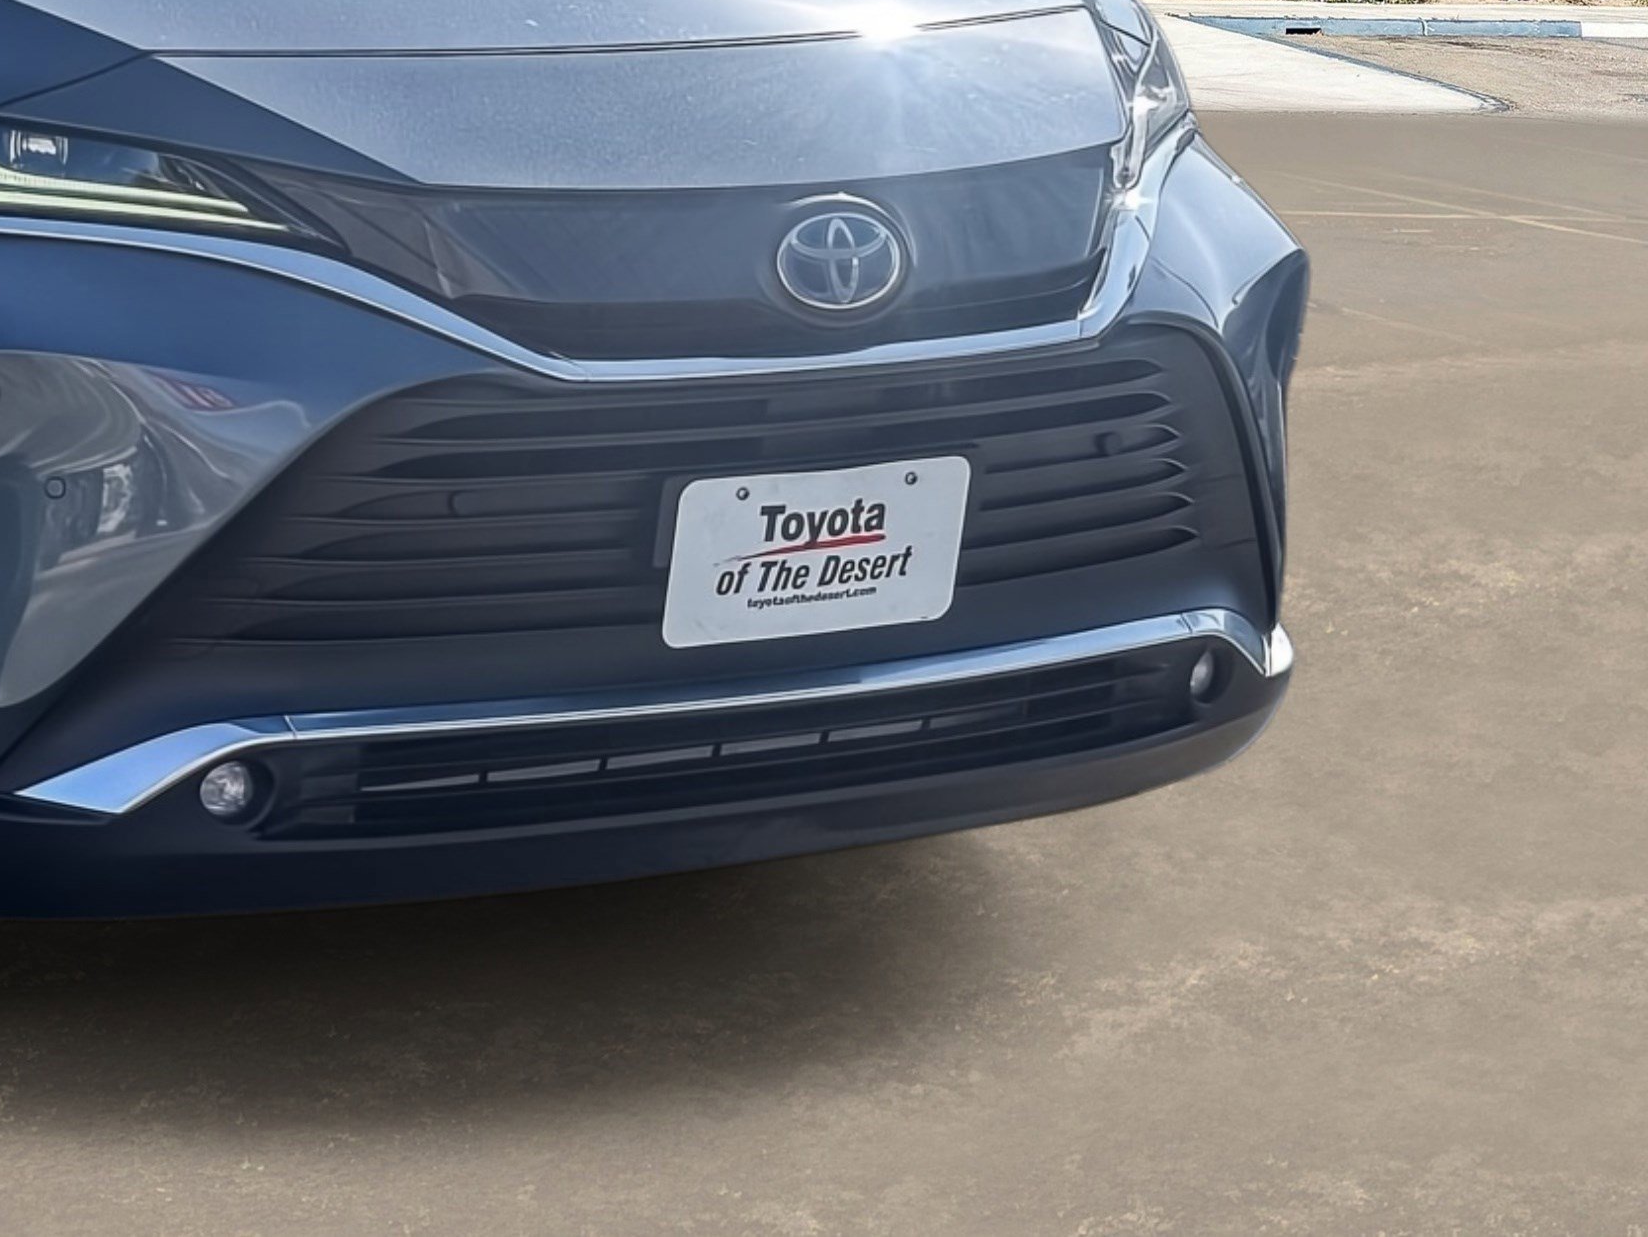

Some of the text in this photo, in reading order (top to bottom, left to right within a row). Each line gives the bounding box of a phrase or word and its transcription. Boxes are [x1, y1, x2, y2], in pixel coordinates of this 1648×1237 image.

[759, 497, 887, 549] Toyota
[716, 545, 913, 596] of The Desert
[746, 586, 877, 609] toyotaofthedesert.com
